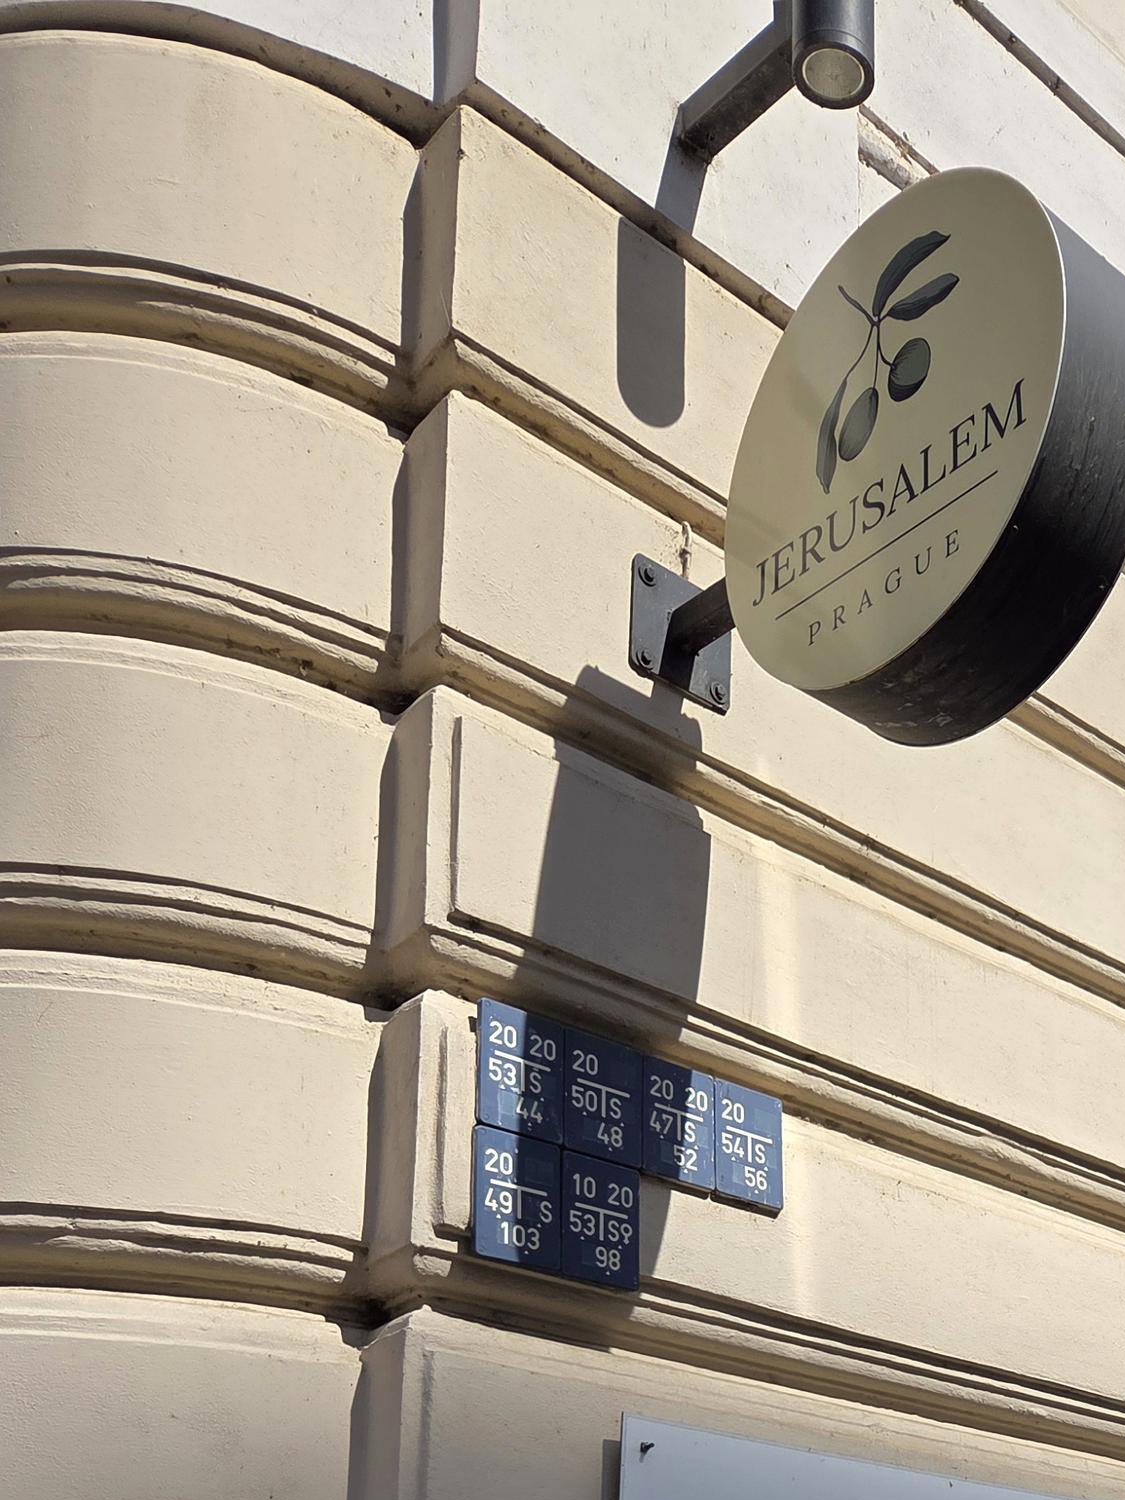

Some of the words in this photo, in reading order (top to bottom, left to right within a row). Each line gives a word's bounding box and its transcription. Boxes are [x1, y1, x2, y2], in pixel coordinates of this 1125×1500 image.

[751, 377, 1028, 607] JERUSALEM
[807, 529, 962, 646] PRAGUE
[488, 1021, 517, 1048] 20
[529, 1034, 556, 1061] 20
[488, 1057, 516, 1085] 53
[529, 1071, 542, 1094] S
[572, 1050, 598, 1075] 20
[571, 1085, 598, 1112] 50
[610, 1098, 622, 1120] S
[650, 1076, 674, 1100] 20
[685, 1087, 708, 1112] 20
[516, 1097, 543, 1124] 44
[721, 1098, 745, 1123] 20
[597, 1122, 623, 1148] 48
[650, 1112, 673, 1135] 47
[684, 1120, 696, 1143] S
[484, 1148, 513, 1175] 20
[673, 1144, 697, 1171] 52
[721, 1132, 744, 1158] 54
[754, 1143, 766, 1164] S
[573, 1173, 596, 1199] 10
[608, 1183, 633, 1209] 20
[744, 1165, 768, 1190] 56
[484, 1187, 513, 1214] 49
[539, 1201, 553, 1224] S
[500, 1221, 540, 1249] 103
[569, 1210, 596, 1237] 53
[595, 1246, 621, 1271] 98
